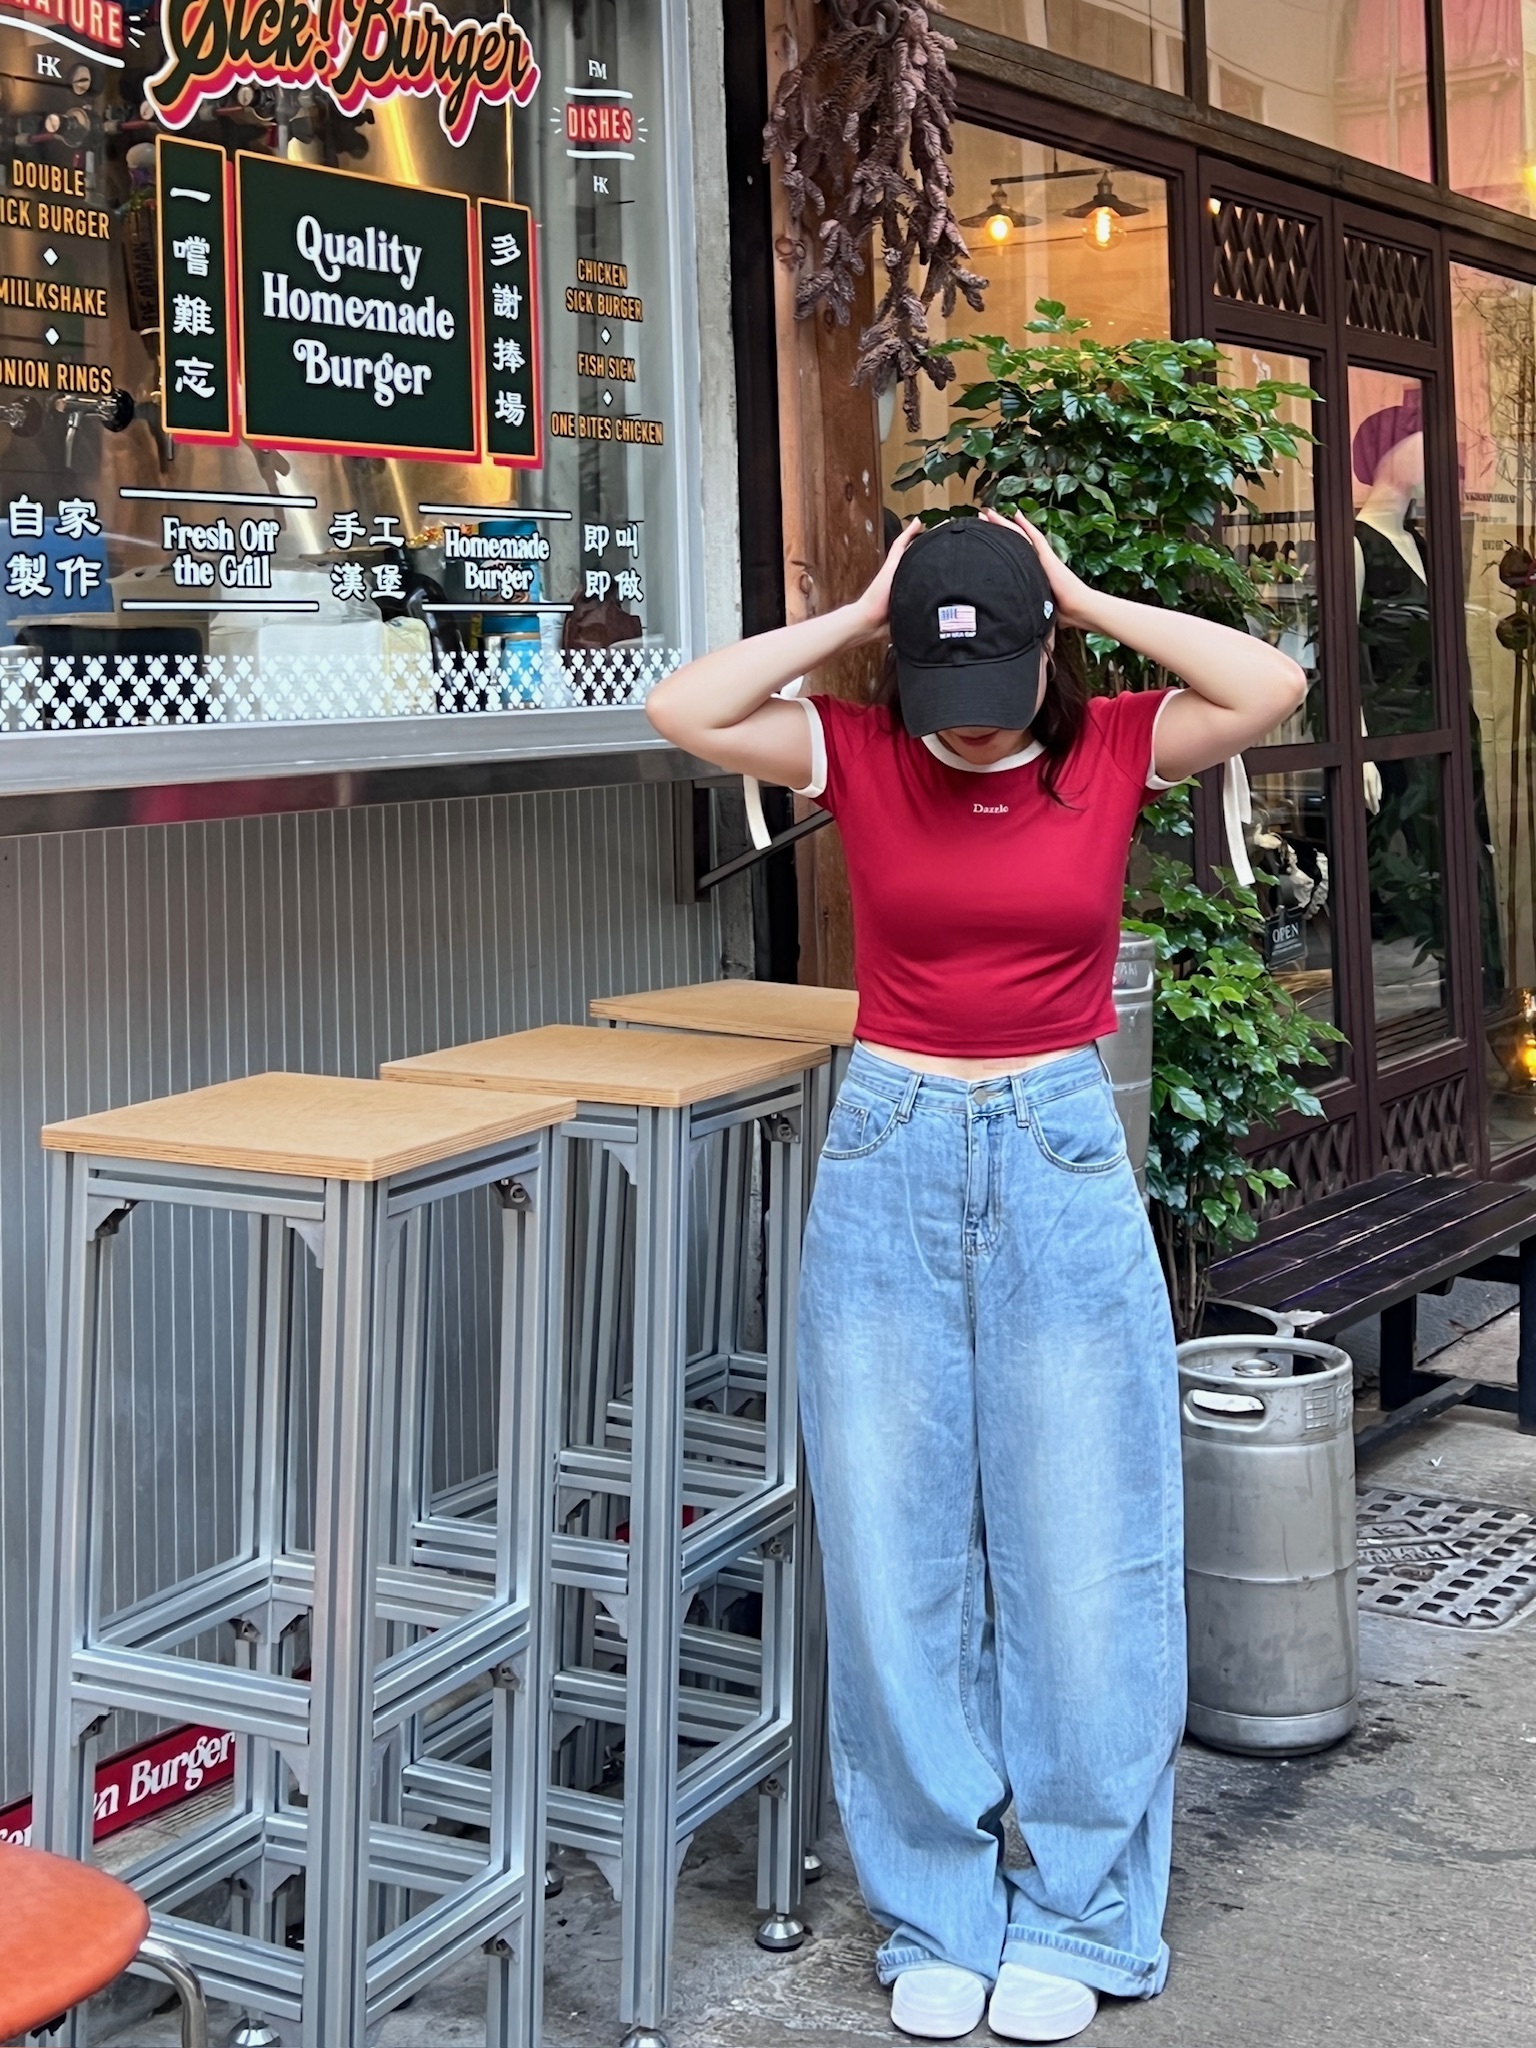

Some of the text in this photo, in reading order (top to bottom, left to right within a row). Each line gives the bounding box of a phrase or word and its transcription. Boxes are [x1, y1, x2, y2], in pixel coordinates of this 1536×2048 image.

[330, 0, 532, 134] Burger
[567, 104, 632, 143] DISHES
[12, 158, 85, 197] DOUBLE
[38, 202, 110, 240] BURGER
[296, 215, 423, 291] Quality
[577, 258, 628, 288] CHICKEN
[262, 270, 455, 340] Homemade
[565, 287, 644, 322] SICK BURGER
[490, 232, 527, 427] 多謝捧場
[0, 357, 113, 395] NION RINGS
[292, 338, 432, 407] Burger
[577, 352, 637, 382] FISH SICK
[551, 412, 664, 445] ONE BITES CHICKEN
[8, 495, 102, 538] 自家
[162, 516, 281, 552] Fresh Off
[328, 511, 406, 549] 手工
[444, 527, 551, 561] Homemade
[583, 524, 639, 558] 即叫
[5, 553, 103, 598] 製作
[172, 553, 272, 588] the Grill
[330, 561, 407, 600] 漢堡
[464, 561, 535, 599] Burger
[584, 569, 644, 602] 即做
[1271, 922, 1300, 944] OPEN
[127, 1731, 236, 1807] Burger
